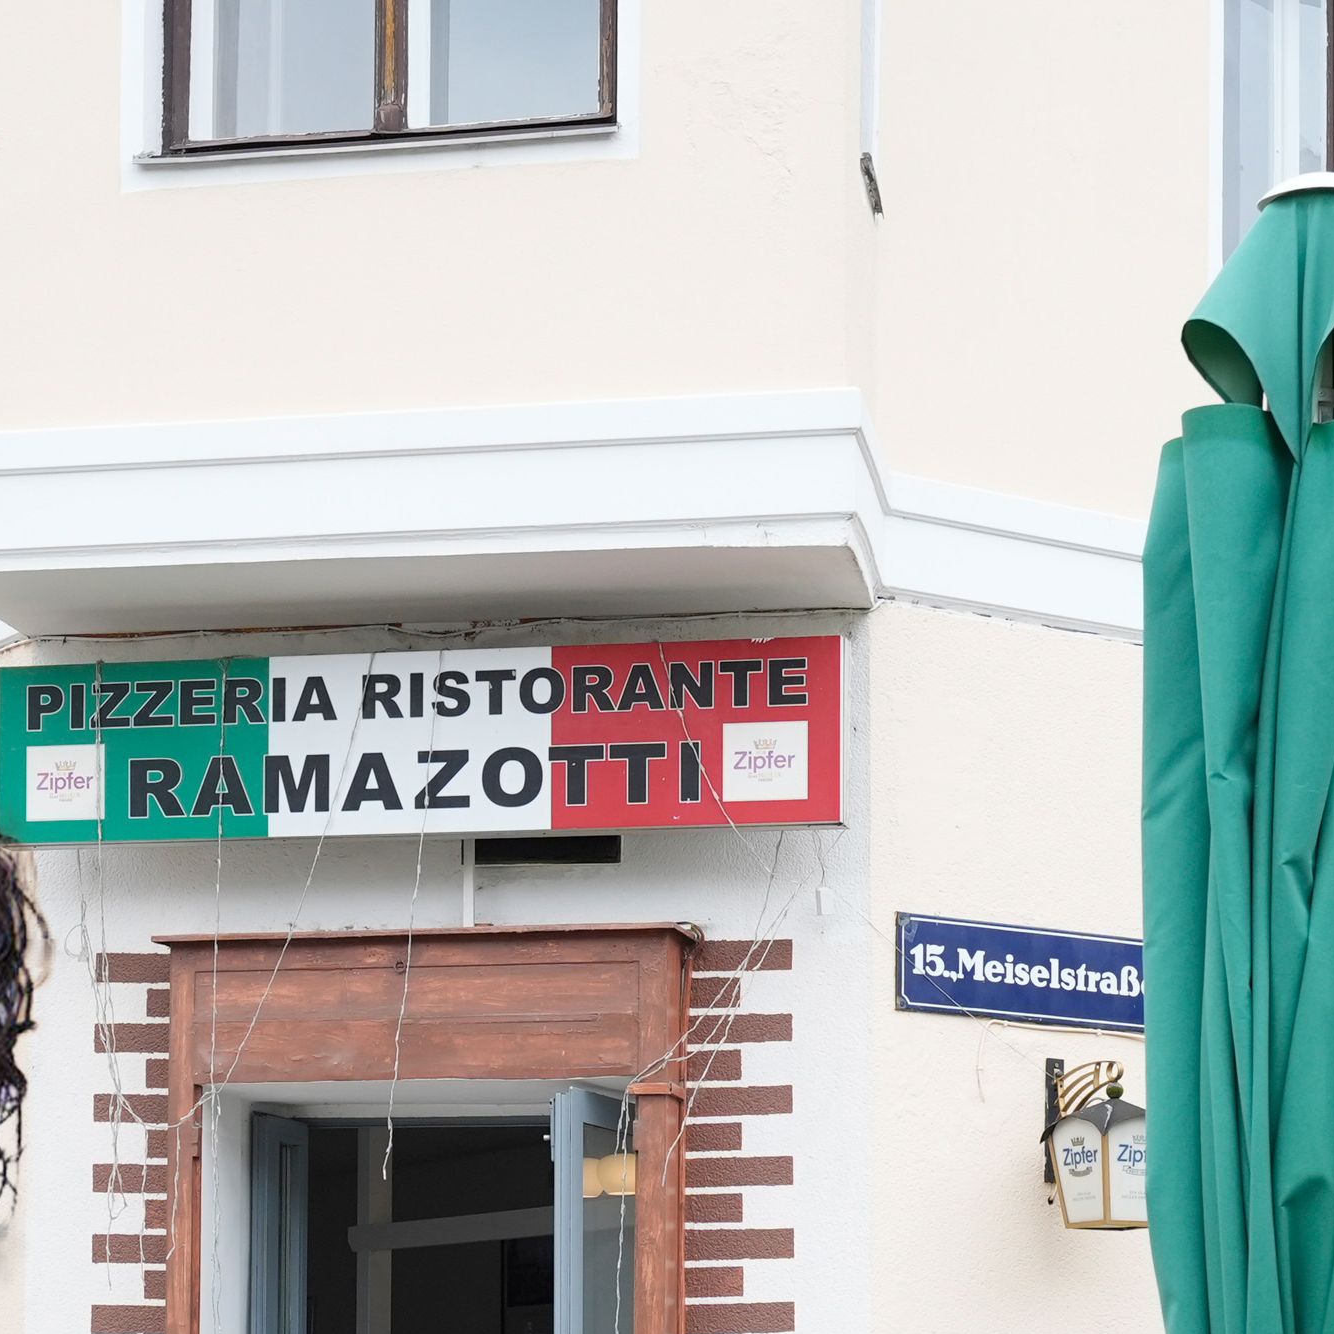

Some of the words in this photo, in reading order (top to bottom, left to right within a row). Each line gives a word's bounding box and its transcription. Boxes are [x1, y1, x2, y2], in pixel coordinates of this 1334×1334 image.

[26, 675, 337, 732] PIZZERIA
[363, 658, 809, 720] RISTORANTE
[128, 740, 703, 819] RAMAZOTTI
[733, 750, 795, 773] Zipfer
[36, 772, 94, 794] Zipfer
[957, 948, 1145, 997] Meiselstraß
[1062, 1146, 1098, 1169] Zipfer
